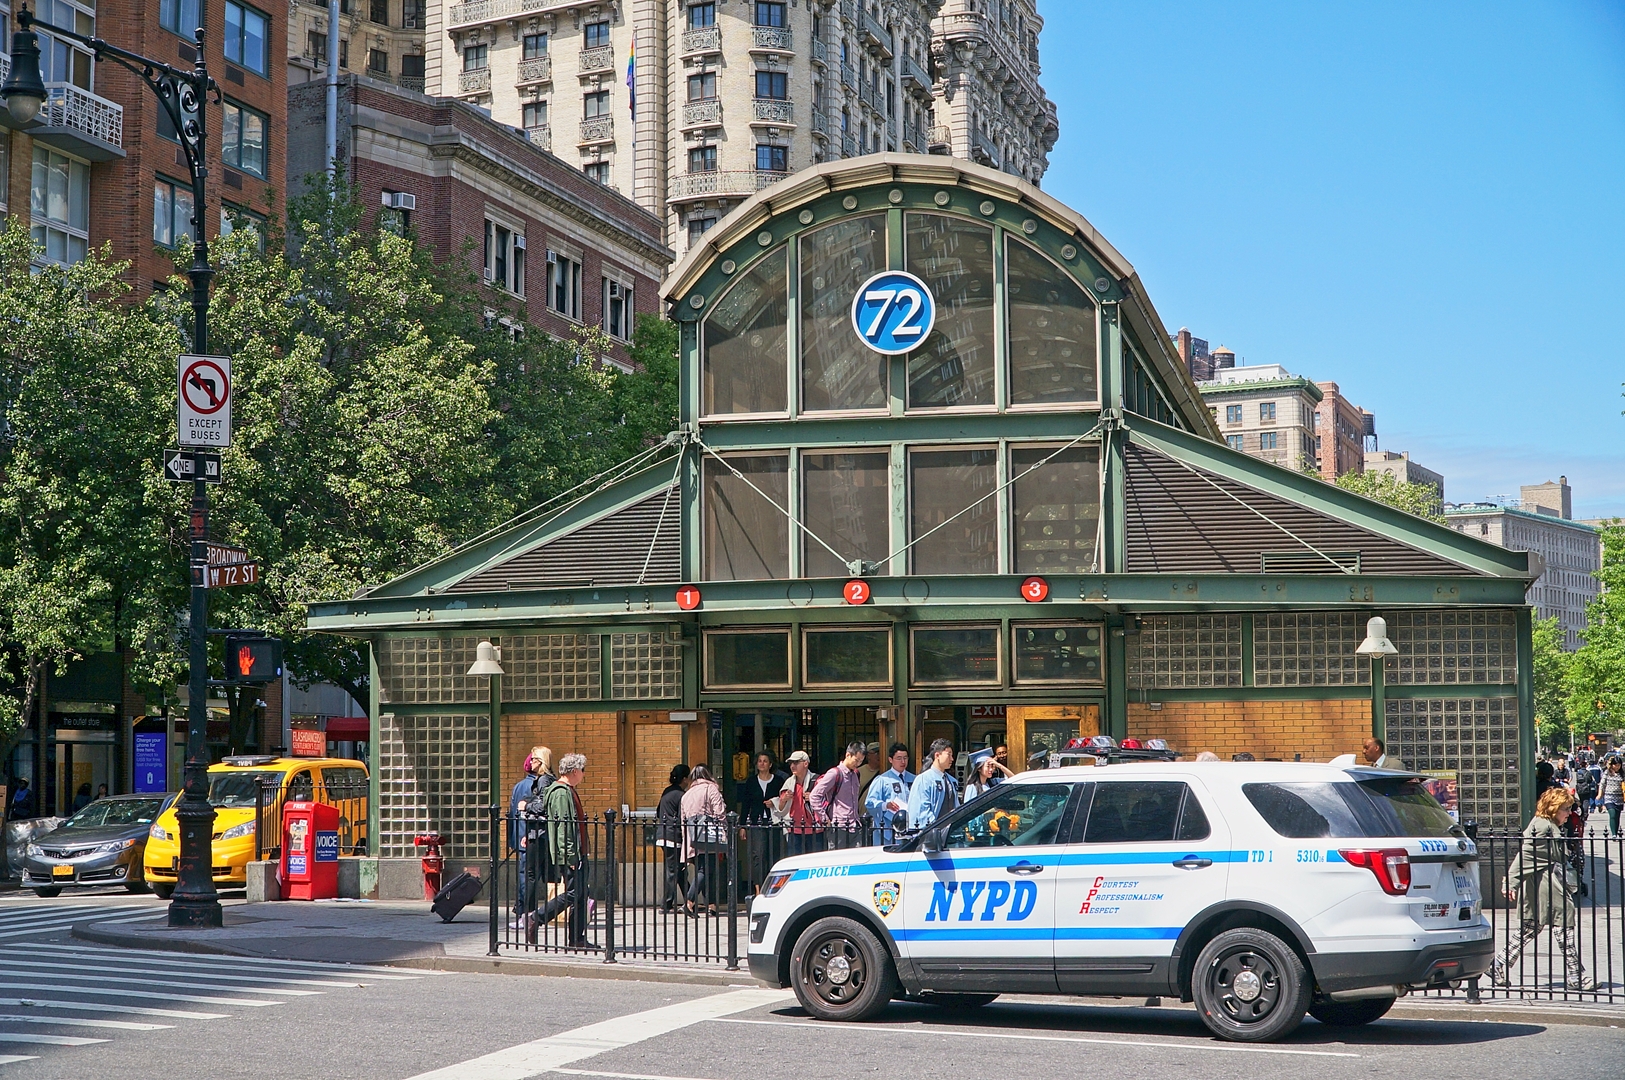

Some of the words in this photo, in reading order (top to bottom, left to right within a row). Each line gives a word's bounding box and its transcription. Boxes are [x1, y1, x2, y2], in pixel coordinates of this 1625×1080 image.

[865, 288, 923, 338] 72
[189, 418, 222, 428] EXCEPT
[190, 430, 220, 440] BUSES
[173, 460, 189, 472] ONE
[206, 546, 247, 565] BROADWAY
[210, 568, 220, 586] W
[224, 567, 238, 584] 72
[242, 565, 254, 582] ST
[317, 835, 337, 848] VOICE
[1418, 840, 1448, 852] NYPD
[289, 857, 305, 865] VOICE
[1251, 850, 1265, 862] TD
[1268, 850, 1273, 862] 1
[1296, 850, 1319, 862] 5310
[809, 866, 849, 879] POLICE
[925, 880, 1038, 922] NYPD
